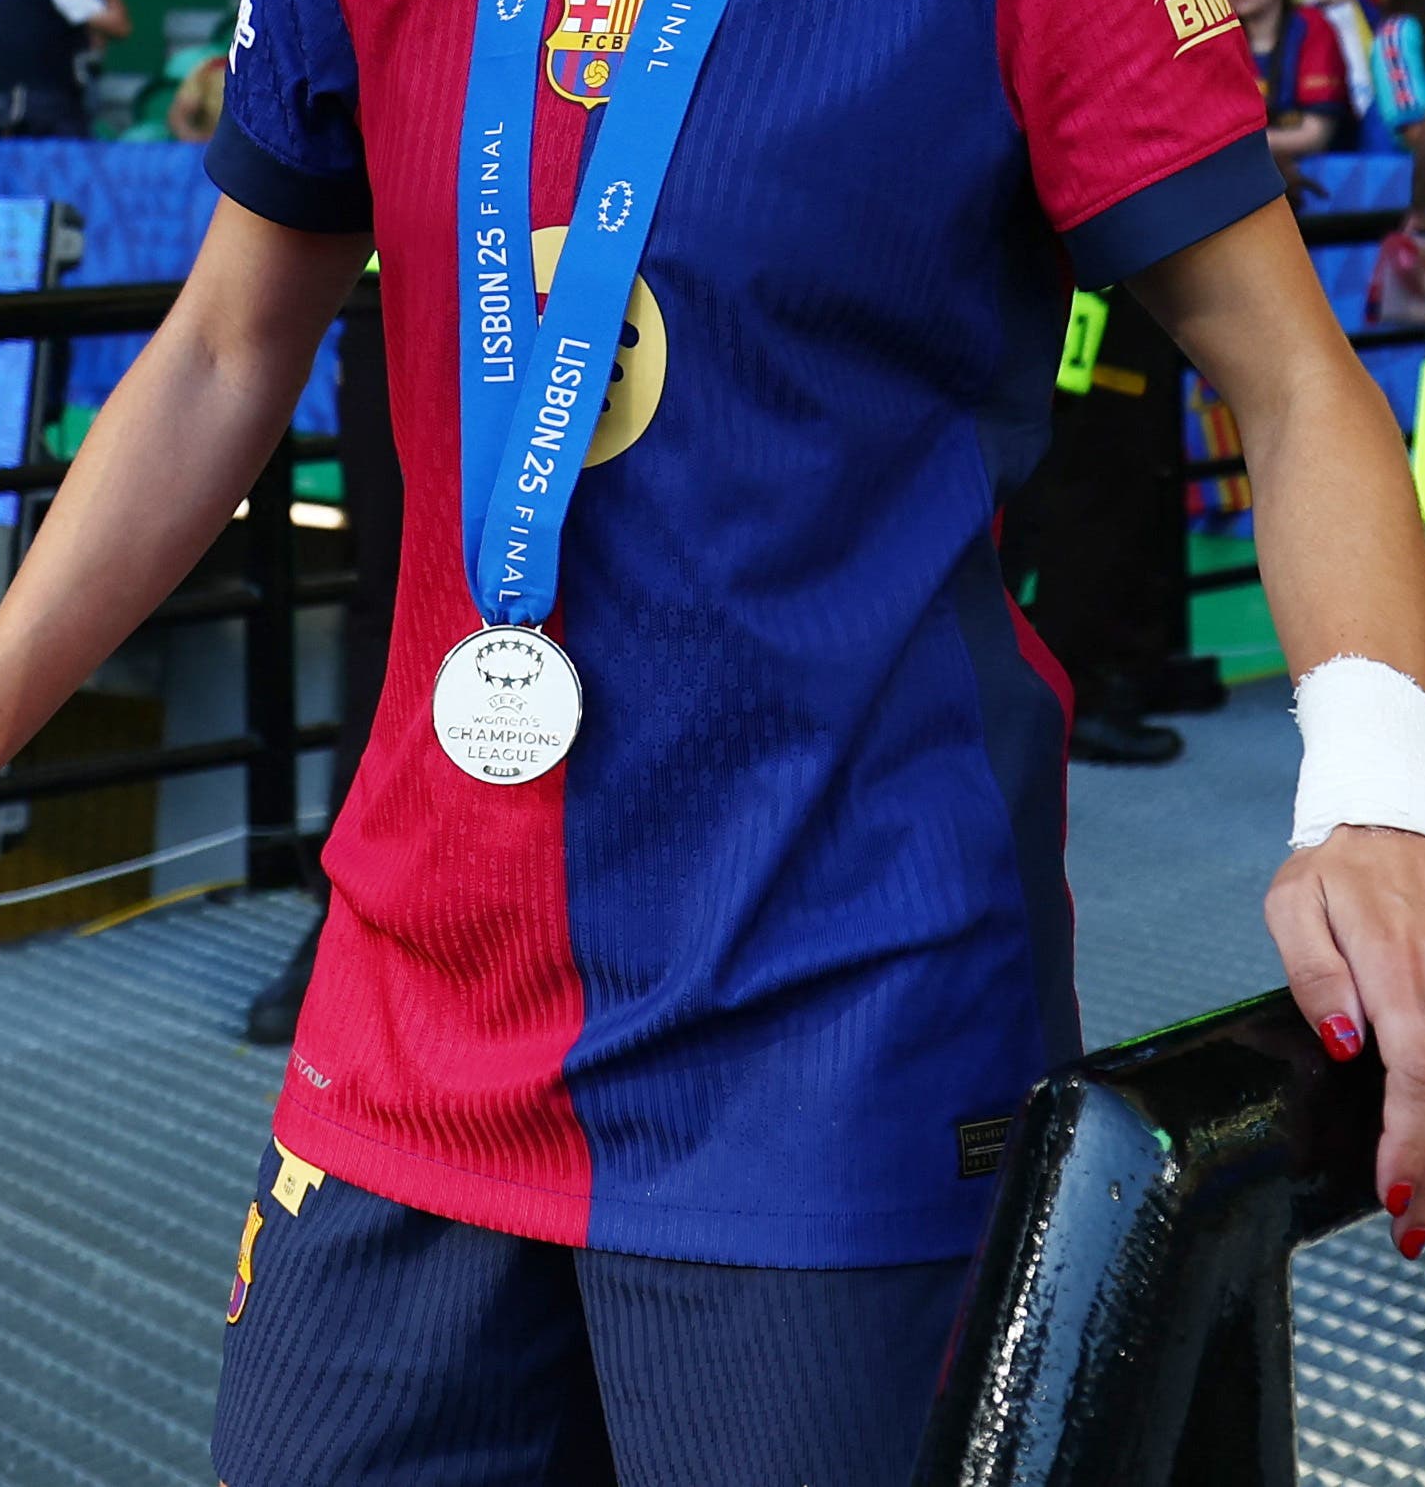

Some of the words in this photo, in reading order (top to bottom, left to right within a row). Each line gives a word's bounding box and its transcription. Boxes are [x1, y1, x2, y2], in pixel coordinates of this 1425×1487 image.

[581, 35, 624, 50] FCB
[480, 121, 504, 215] FINAL
[476, 227, 508, 266] 25
[478, 271, 515, 383] LISBON
[530, 337, 591, 451] LISBON
[518, 451, 555, 494] 25
[498, 505, 535, 603] FINAL
[488, 696, 525, 711] UEFA
[447, 726, 561, 747] CHAMPIONS
[467, 746, 540, 763] LEAGUE
